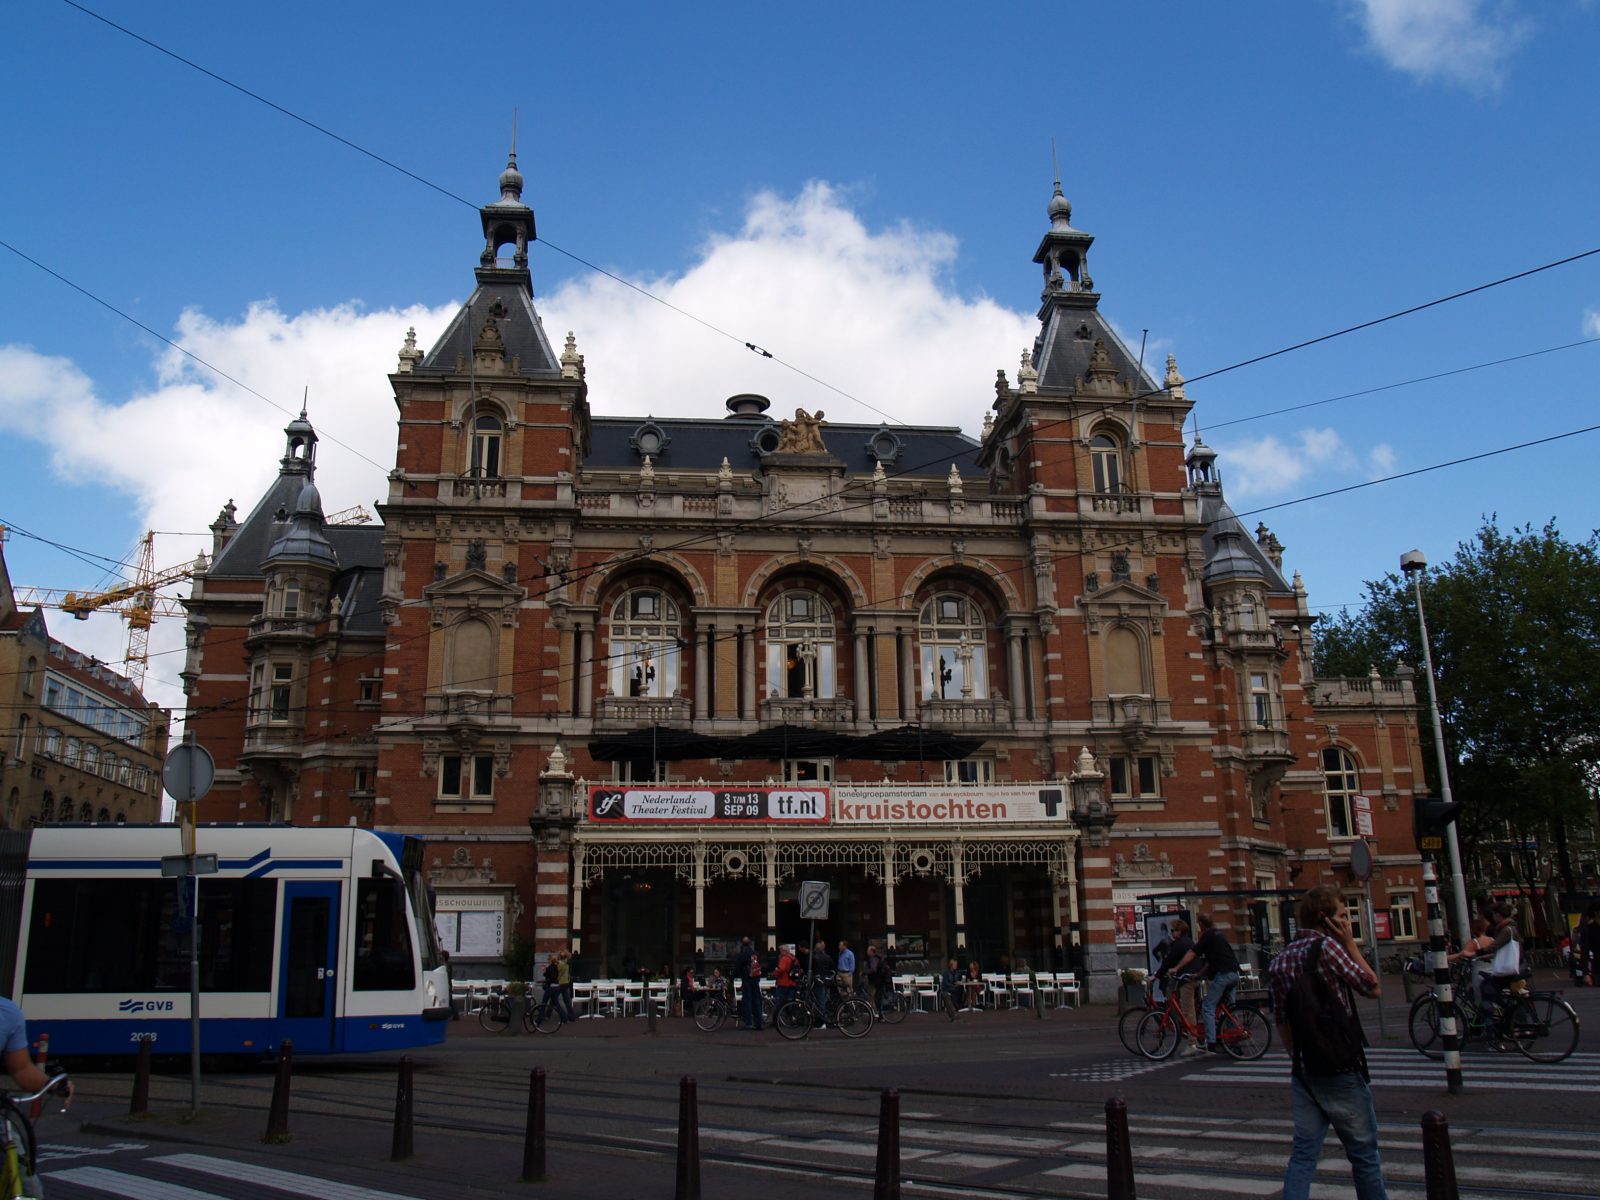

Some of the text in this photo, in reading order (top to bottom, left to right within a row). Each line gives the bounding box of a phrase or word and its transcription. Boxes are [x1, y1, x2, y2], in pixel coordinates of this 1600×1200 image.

[642, 795, 696, 804] Nederlands
[724, 793, 759, 804] 3 T/M 13
[838, 790, 927, 799] toneelgroepamsterdam
[632, 805, 707, 814] Theater Festival
[724, 805, 759, 816] SEP 09
[777, 796, 816, 815] tf.nl
[838, 799, 1007, 820] kruistochten
[145, 1001, 174, 1011] GVB
